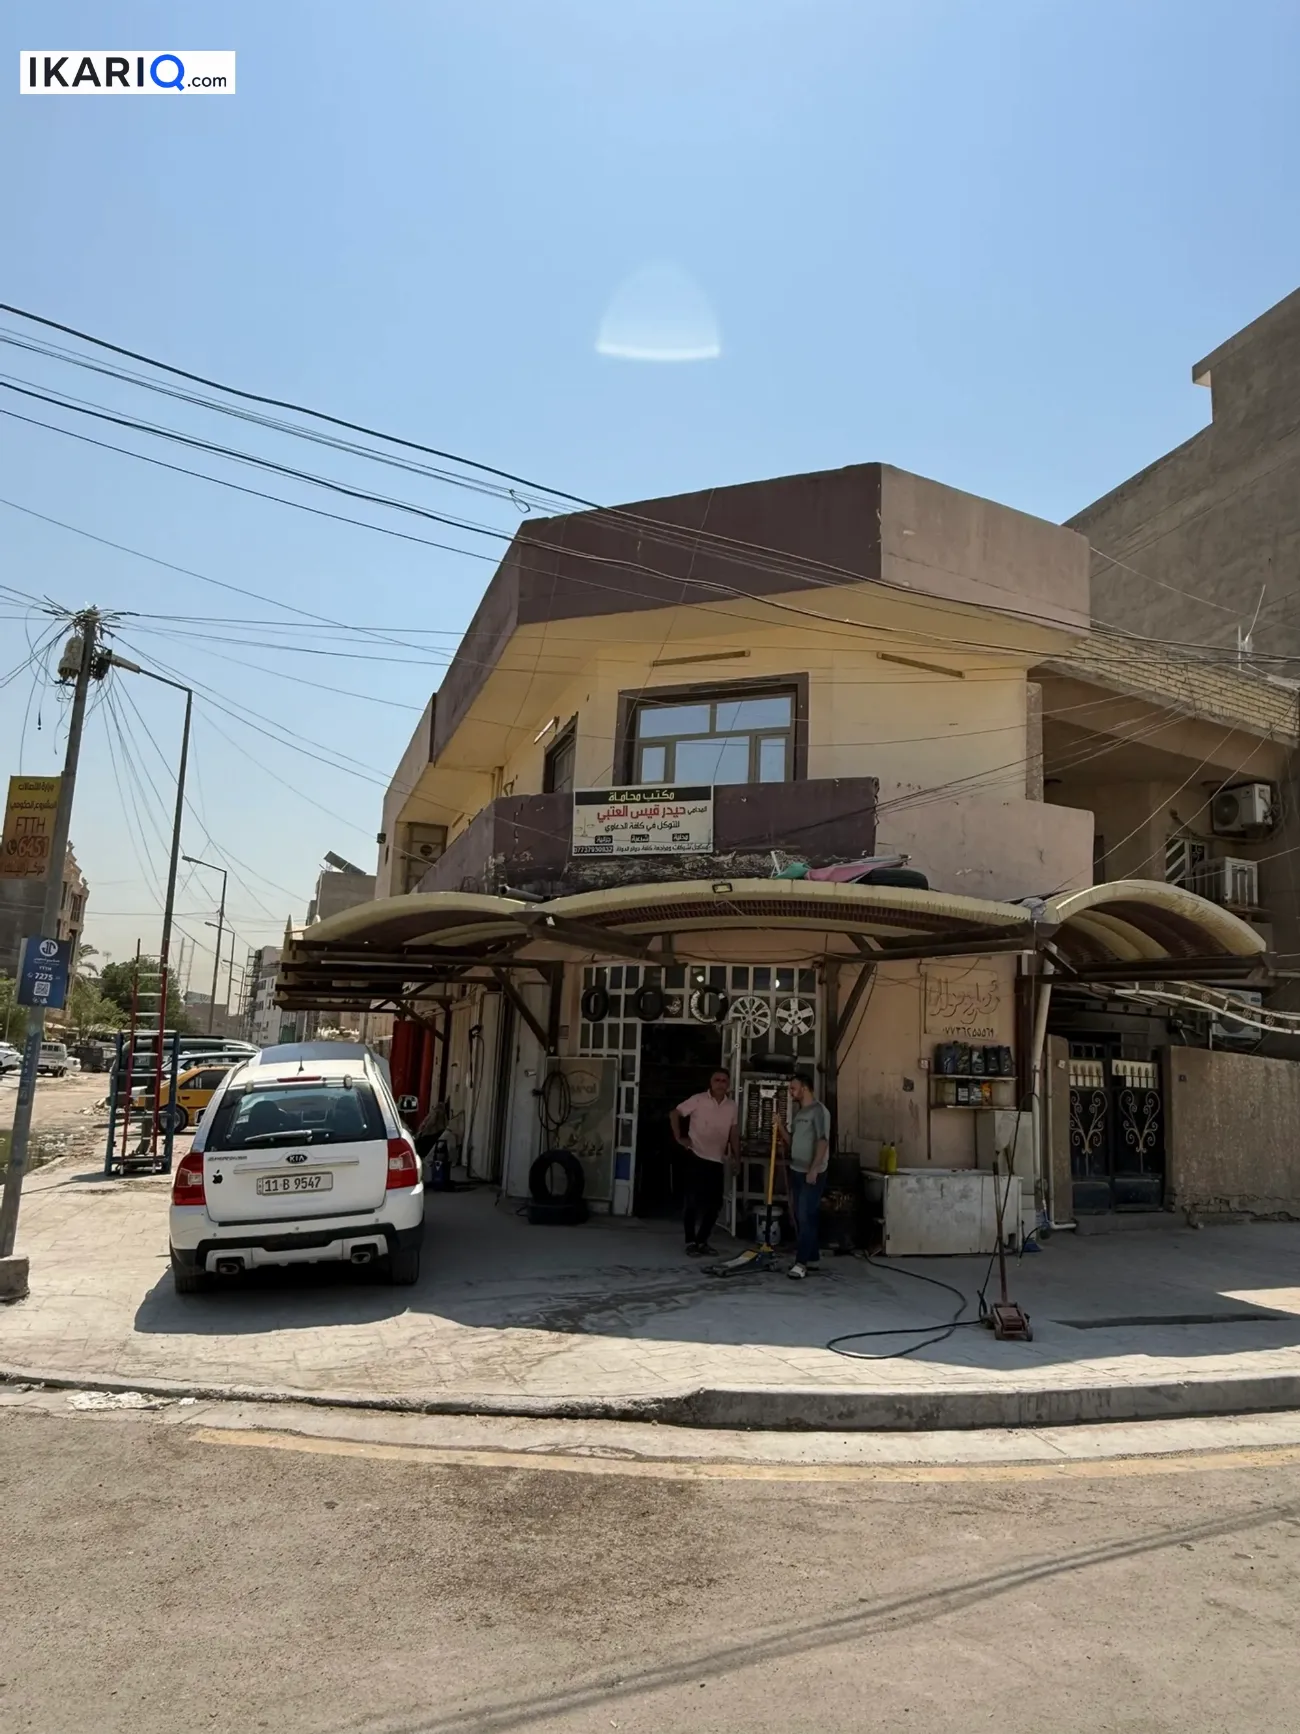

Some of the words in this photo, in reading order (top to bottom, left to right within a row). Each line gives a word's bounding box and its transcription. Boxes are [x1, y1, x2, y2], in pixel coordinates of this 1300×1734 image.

[608, 792, 641, 802] محاماة
[642, 790, 675, 800] مكتب
[597, 805, 629, 823] العتبي
[630, 804, 660, 819] قيس
[661, 806, 686, 818] حيدر
[687, 806, 708, 815] المحامي
[15, 817, 46, 835] FTTH
[629, 822, 645, 830] كافة
[646, 822, 656, 831] في
[657, 821, 680, 831] للتوكل
[18, 836, 50, 858] 6451
[35, 972, 53, 981] 7275
[289, 1155, 306, 1163] KIA
[264, 1179, 279, 1192] 11
[282, 1178, 290, 1191] B
[294, 1176, 321, 1190] 9547
